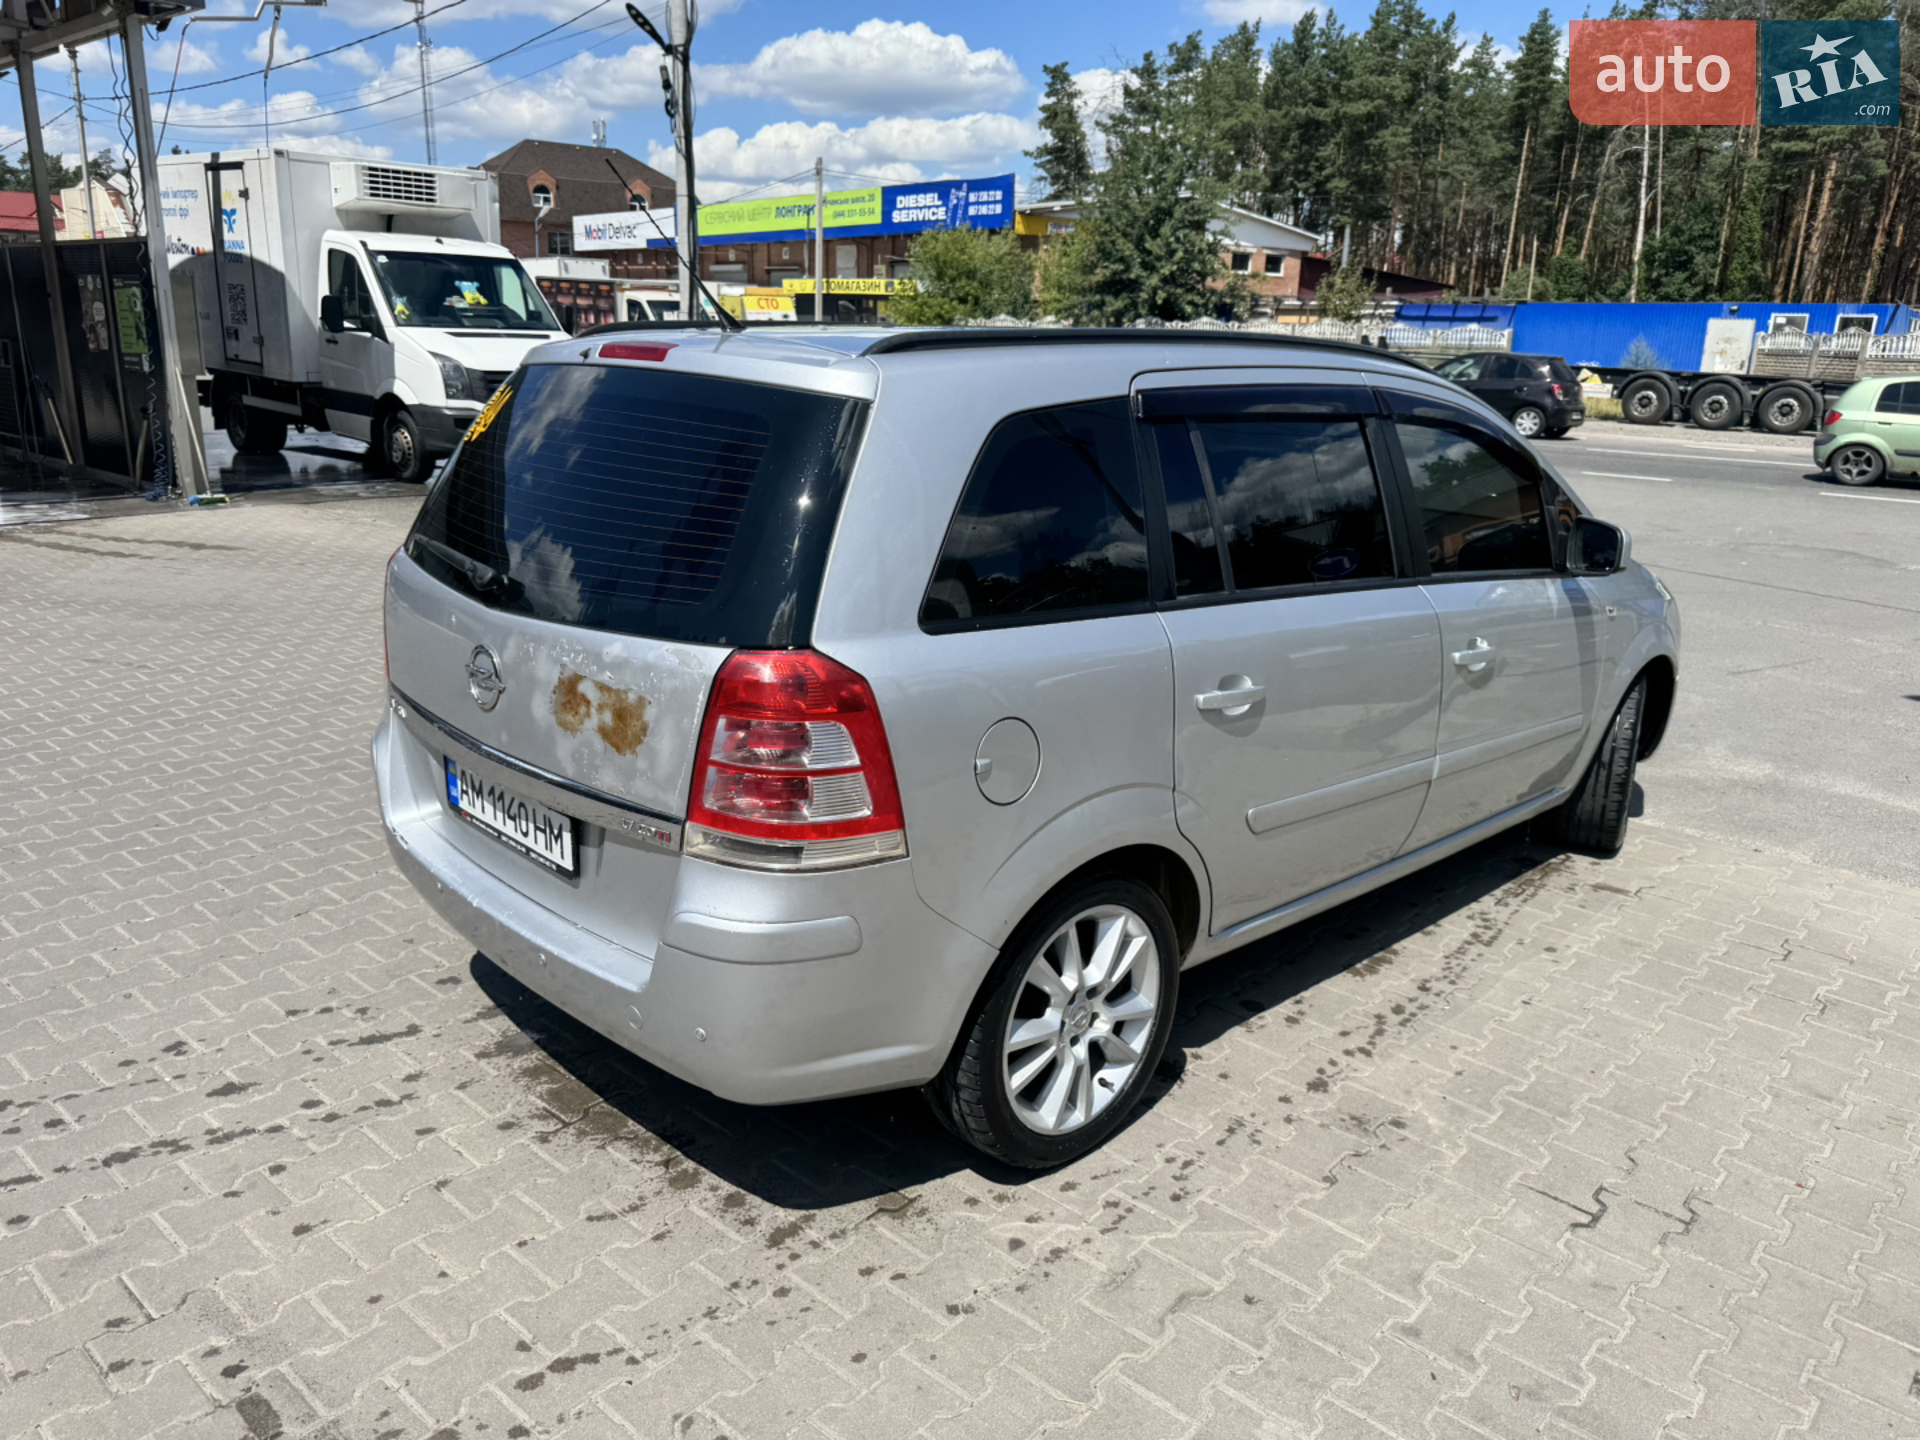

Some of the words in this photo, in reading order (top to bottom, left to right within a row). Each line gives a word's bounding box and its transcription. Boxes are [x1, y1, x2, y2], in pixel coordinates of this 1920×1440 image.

[896, 192, 943, 209] DIESEL
[747, 206, 773, 222] ЦЕНТР
[892, 206, 947, 224] SERVICE
[584, 224, 608, 241] Mobil
[608, 223, 638, 240] Delvac
[756, 298, 780, 310] СТО
[461, 769, 486, 815] AM
[487, 785, 530, 839] 1140
[532, 806, 565, 861] HM
